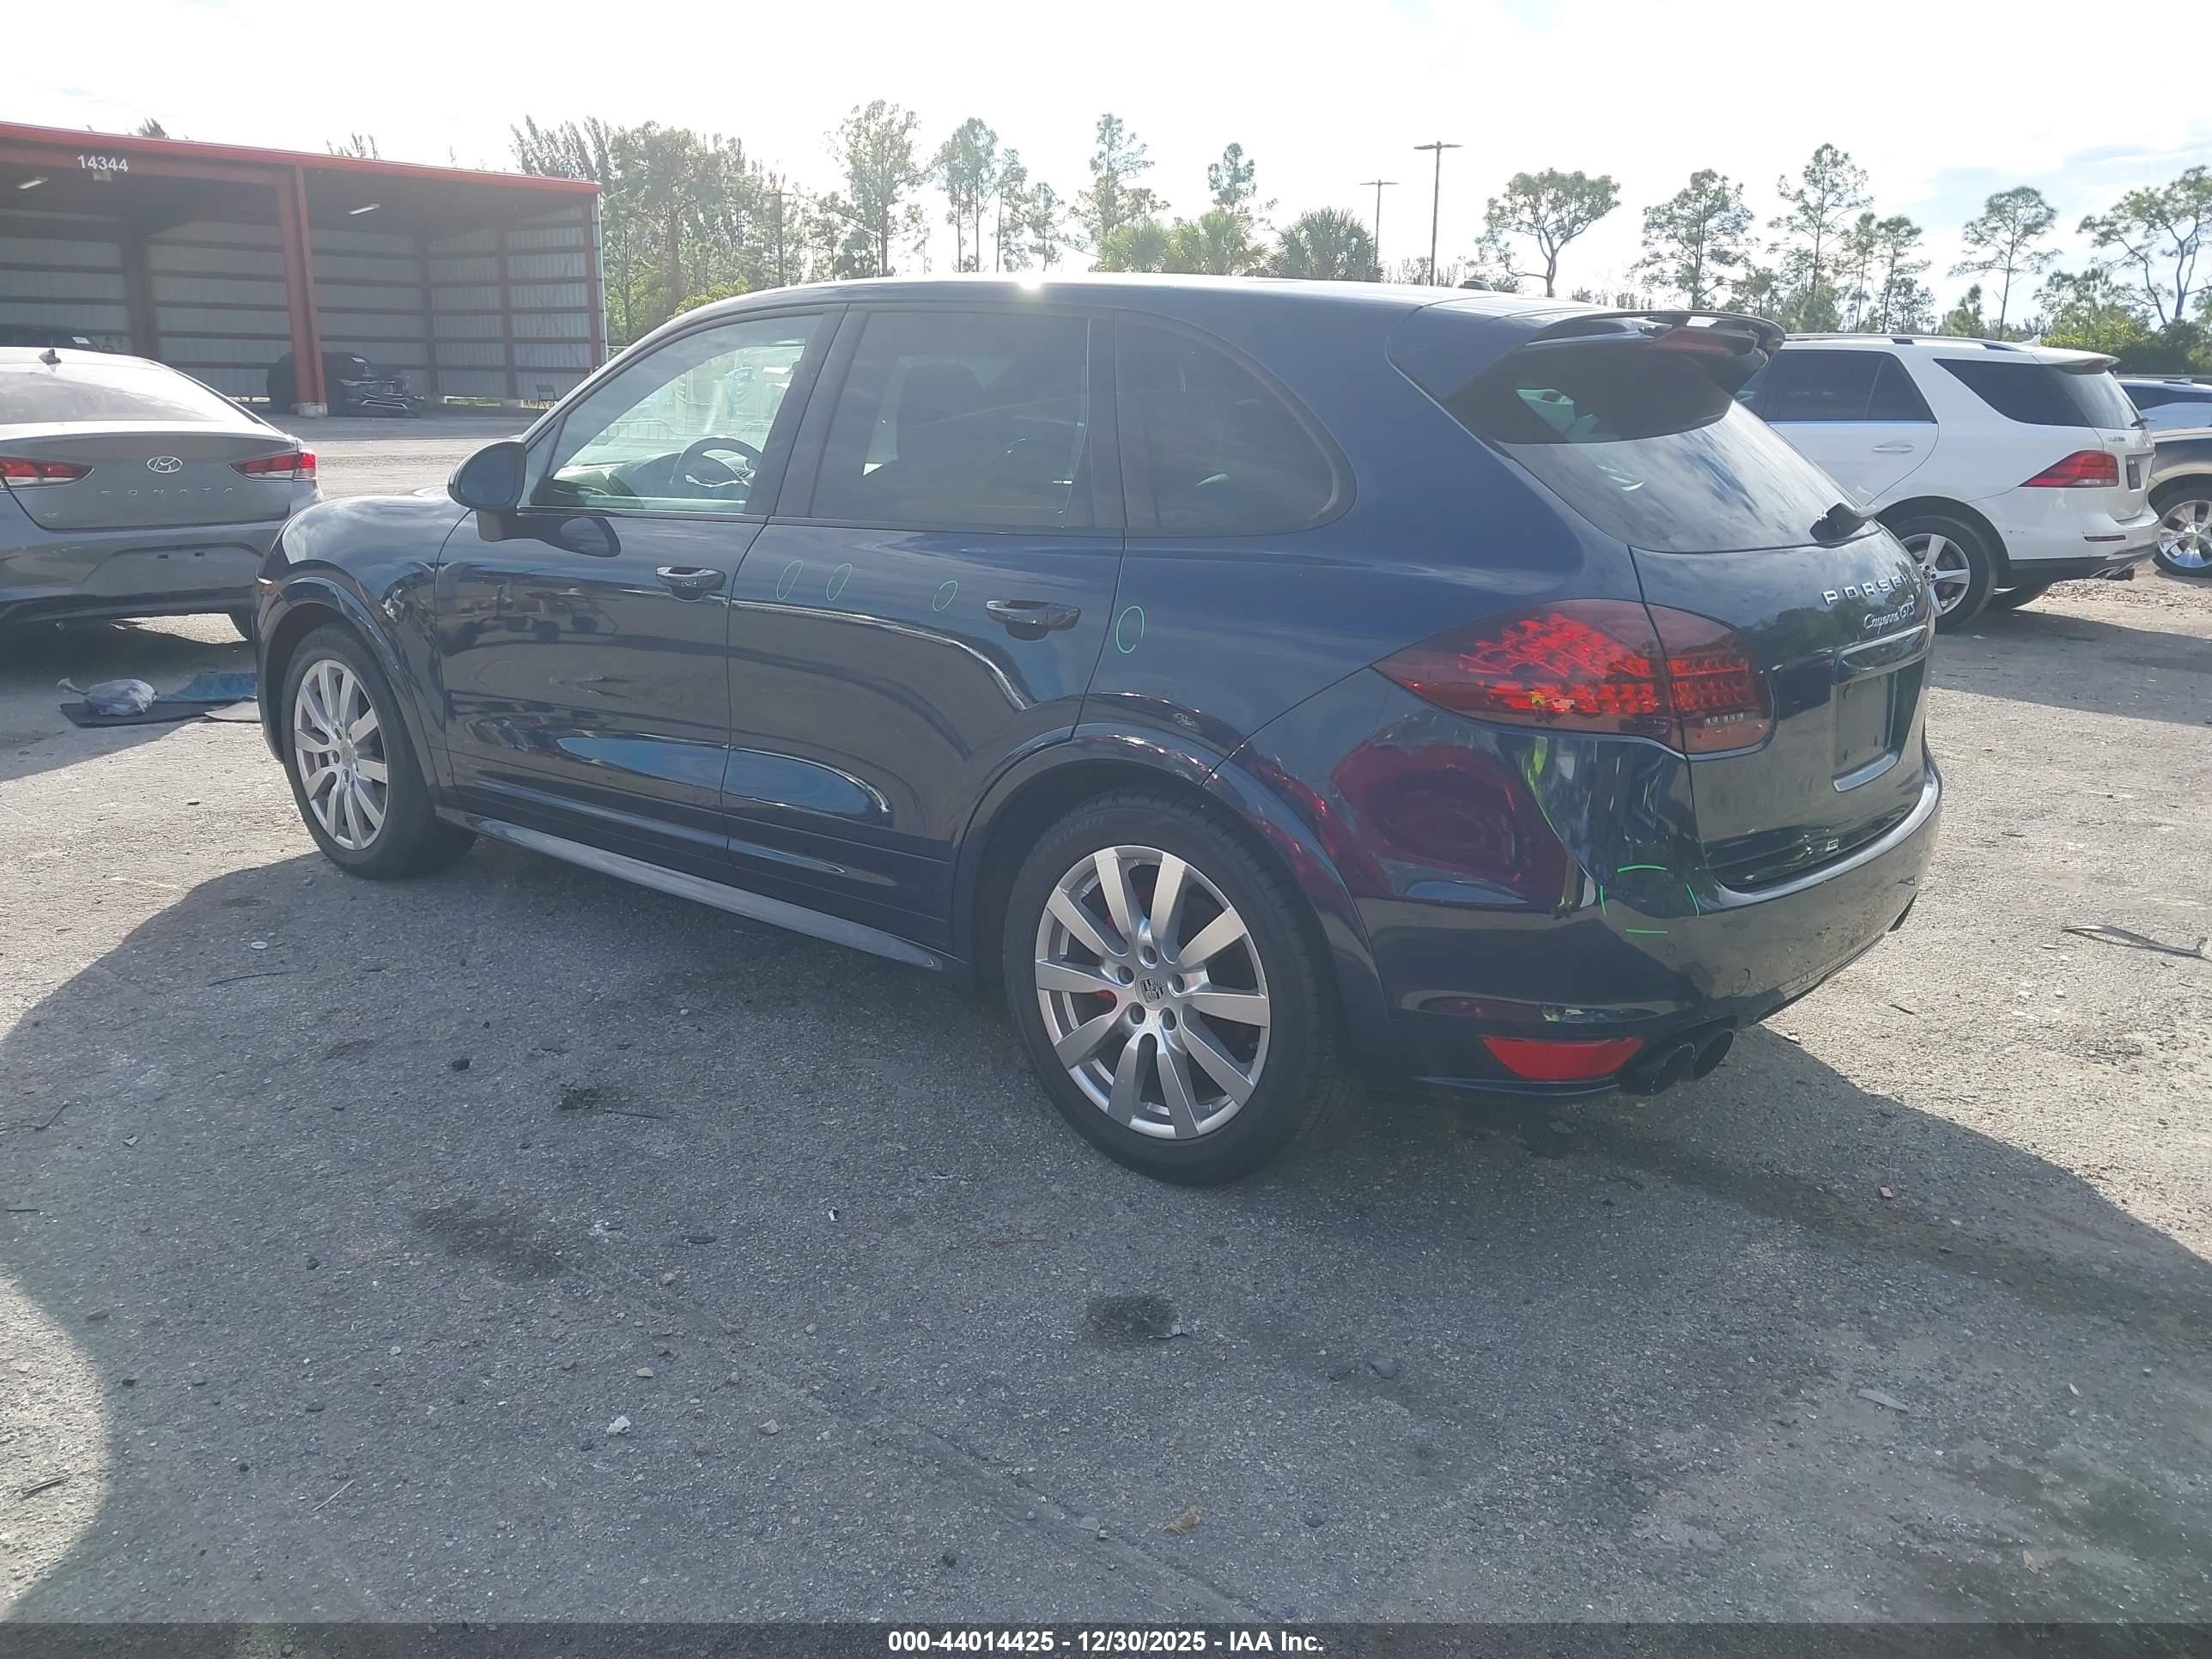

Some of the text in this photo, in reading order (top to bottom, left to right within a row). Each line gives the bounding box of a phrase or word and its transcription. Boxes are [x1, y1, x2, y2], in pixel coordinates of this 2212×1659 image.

[77, 155, 129, 172] 14344
[1821, 569, 1921, 605] PORSCHE
[1899, 600, 1916, 619] GTS
